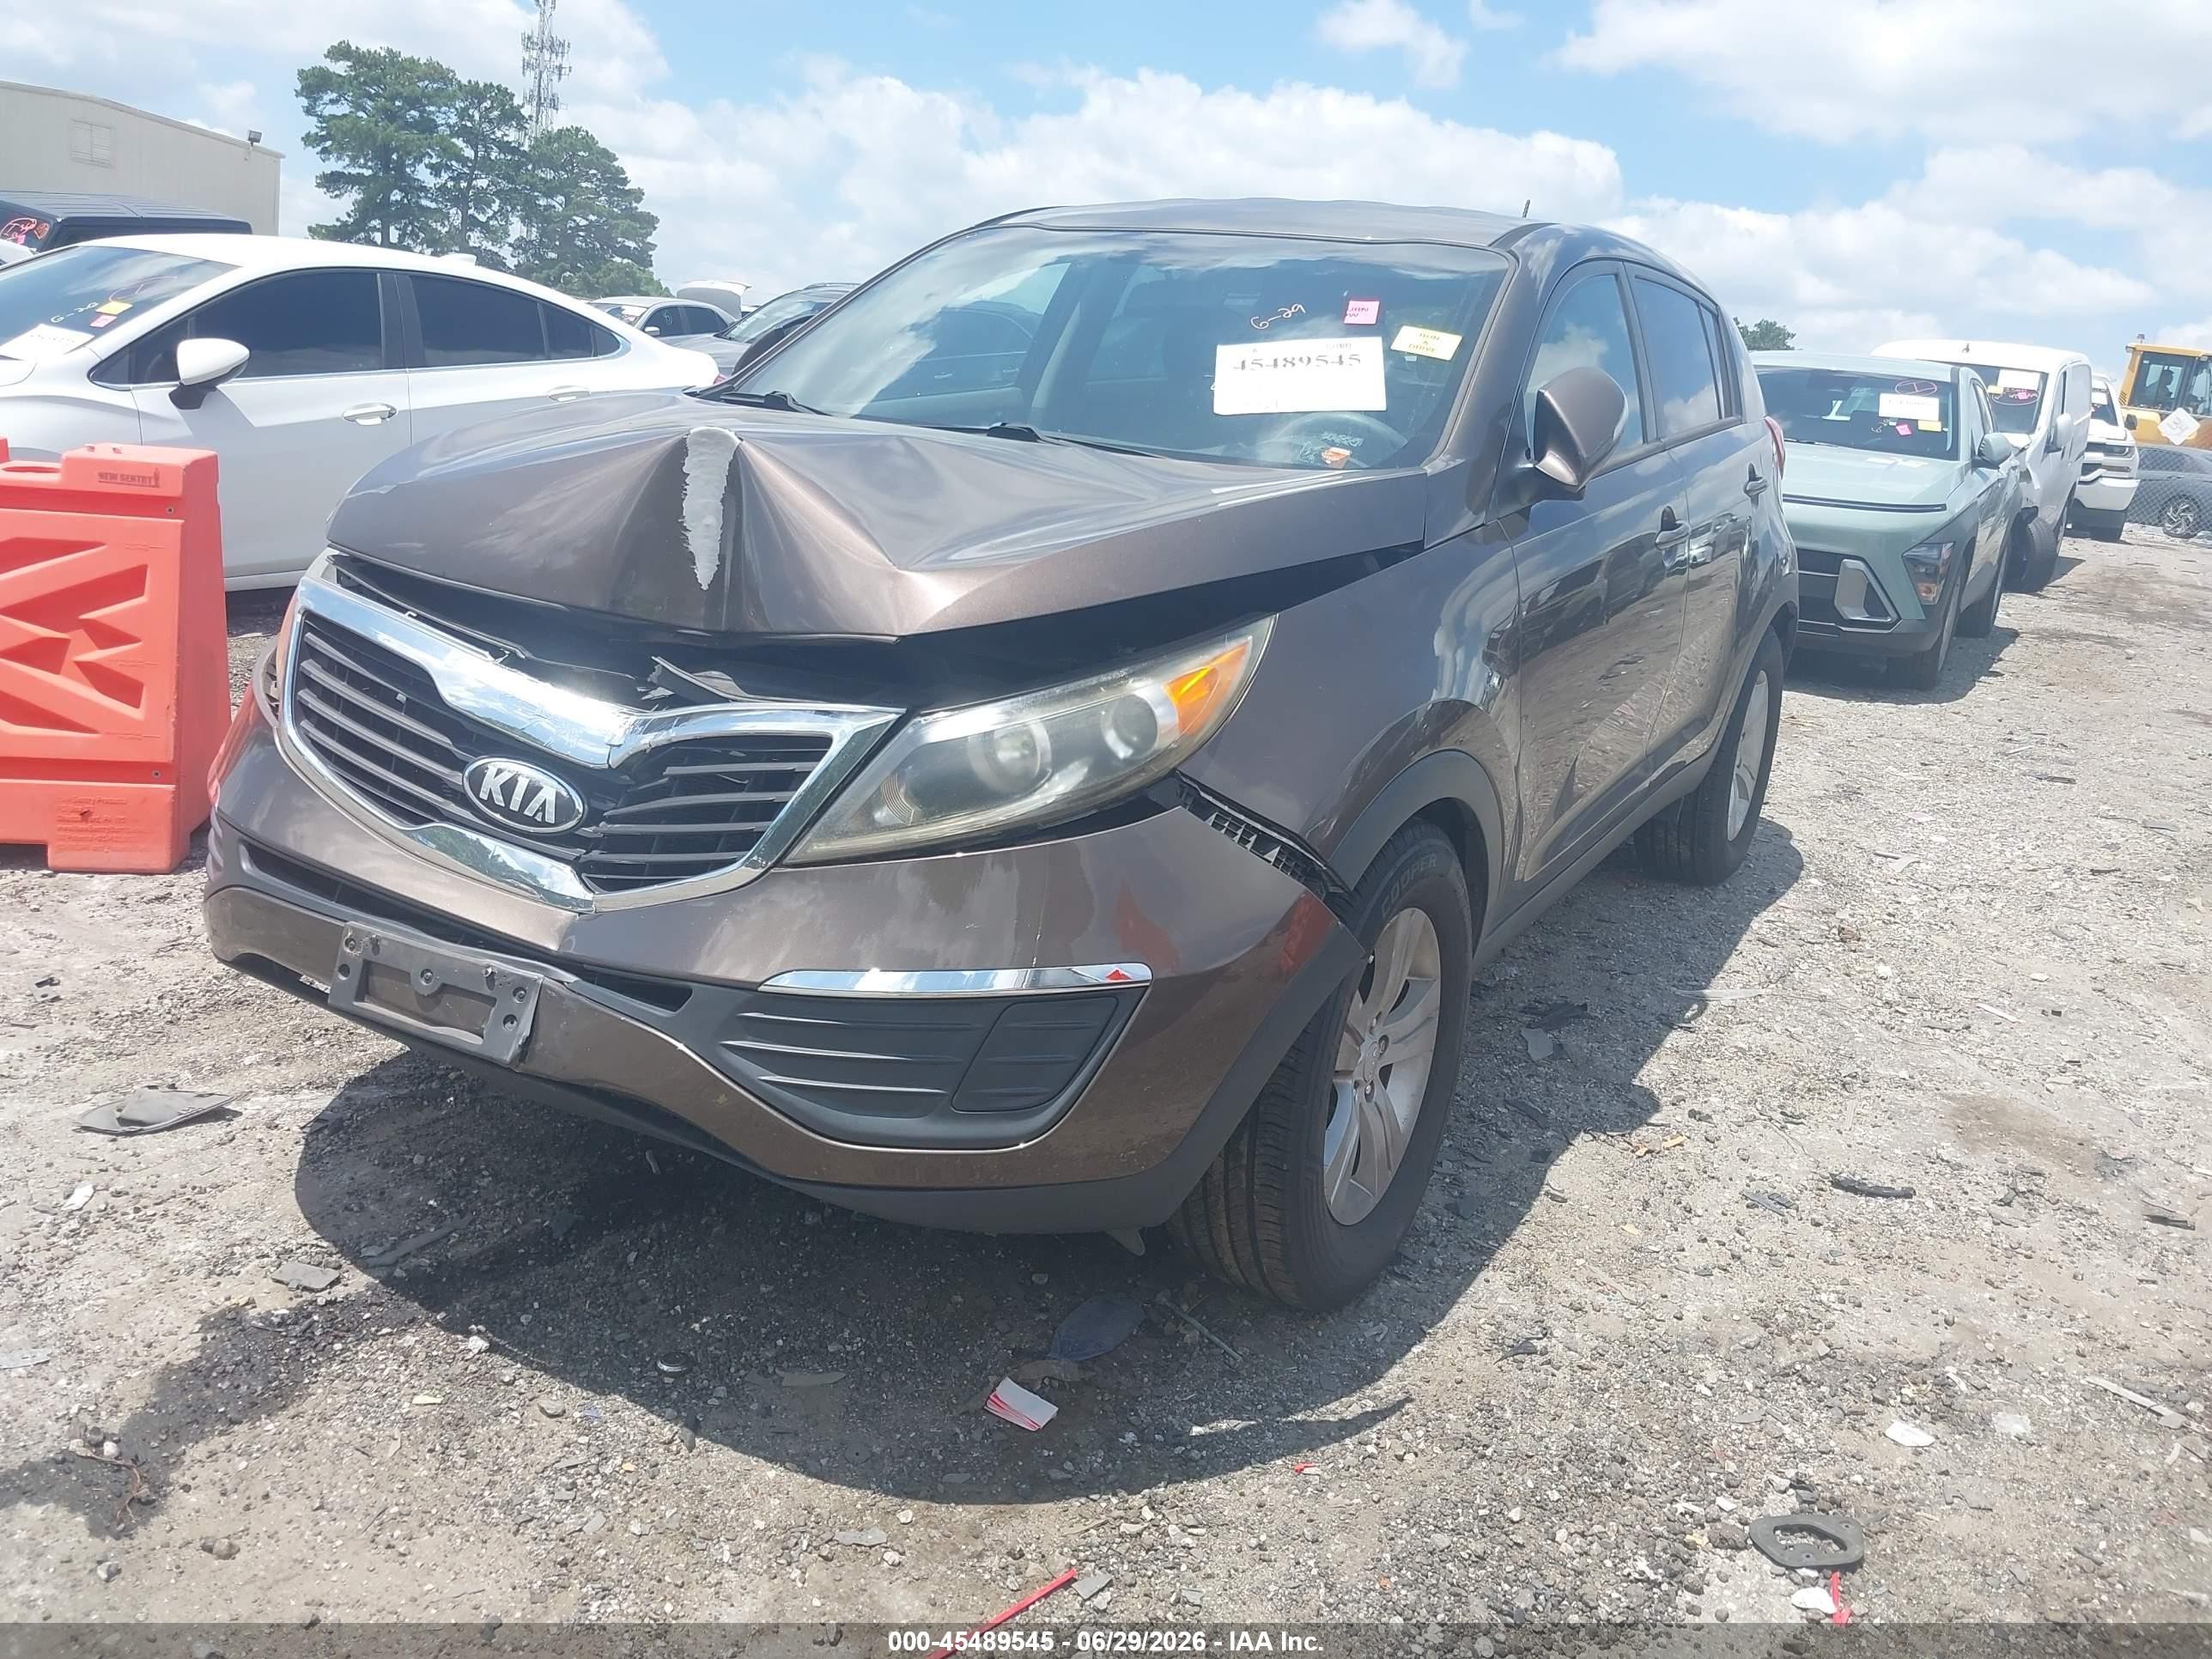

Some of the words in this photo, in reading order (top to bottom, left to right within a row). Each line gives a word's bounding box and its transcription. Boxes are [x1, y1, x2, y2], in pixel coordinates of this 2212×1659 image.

[1250, 303, 1306, 330] 6-29
[1232, 353, 1361, 371] 45489545
[478, 764, 556, 824] KIA
[1381, 852, 1437, 919] COOPER
